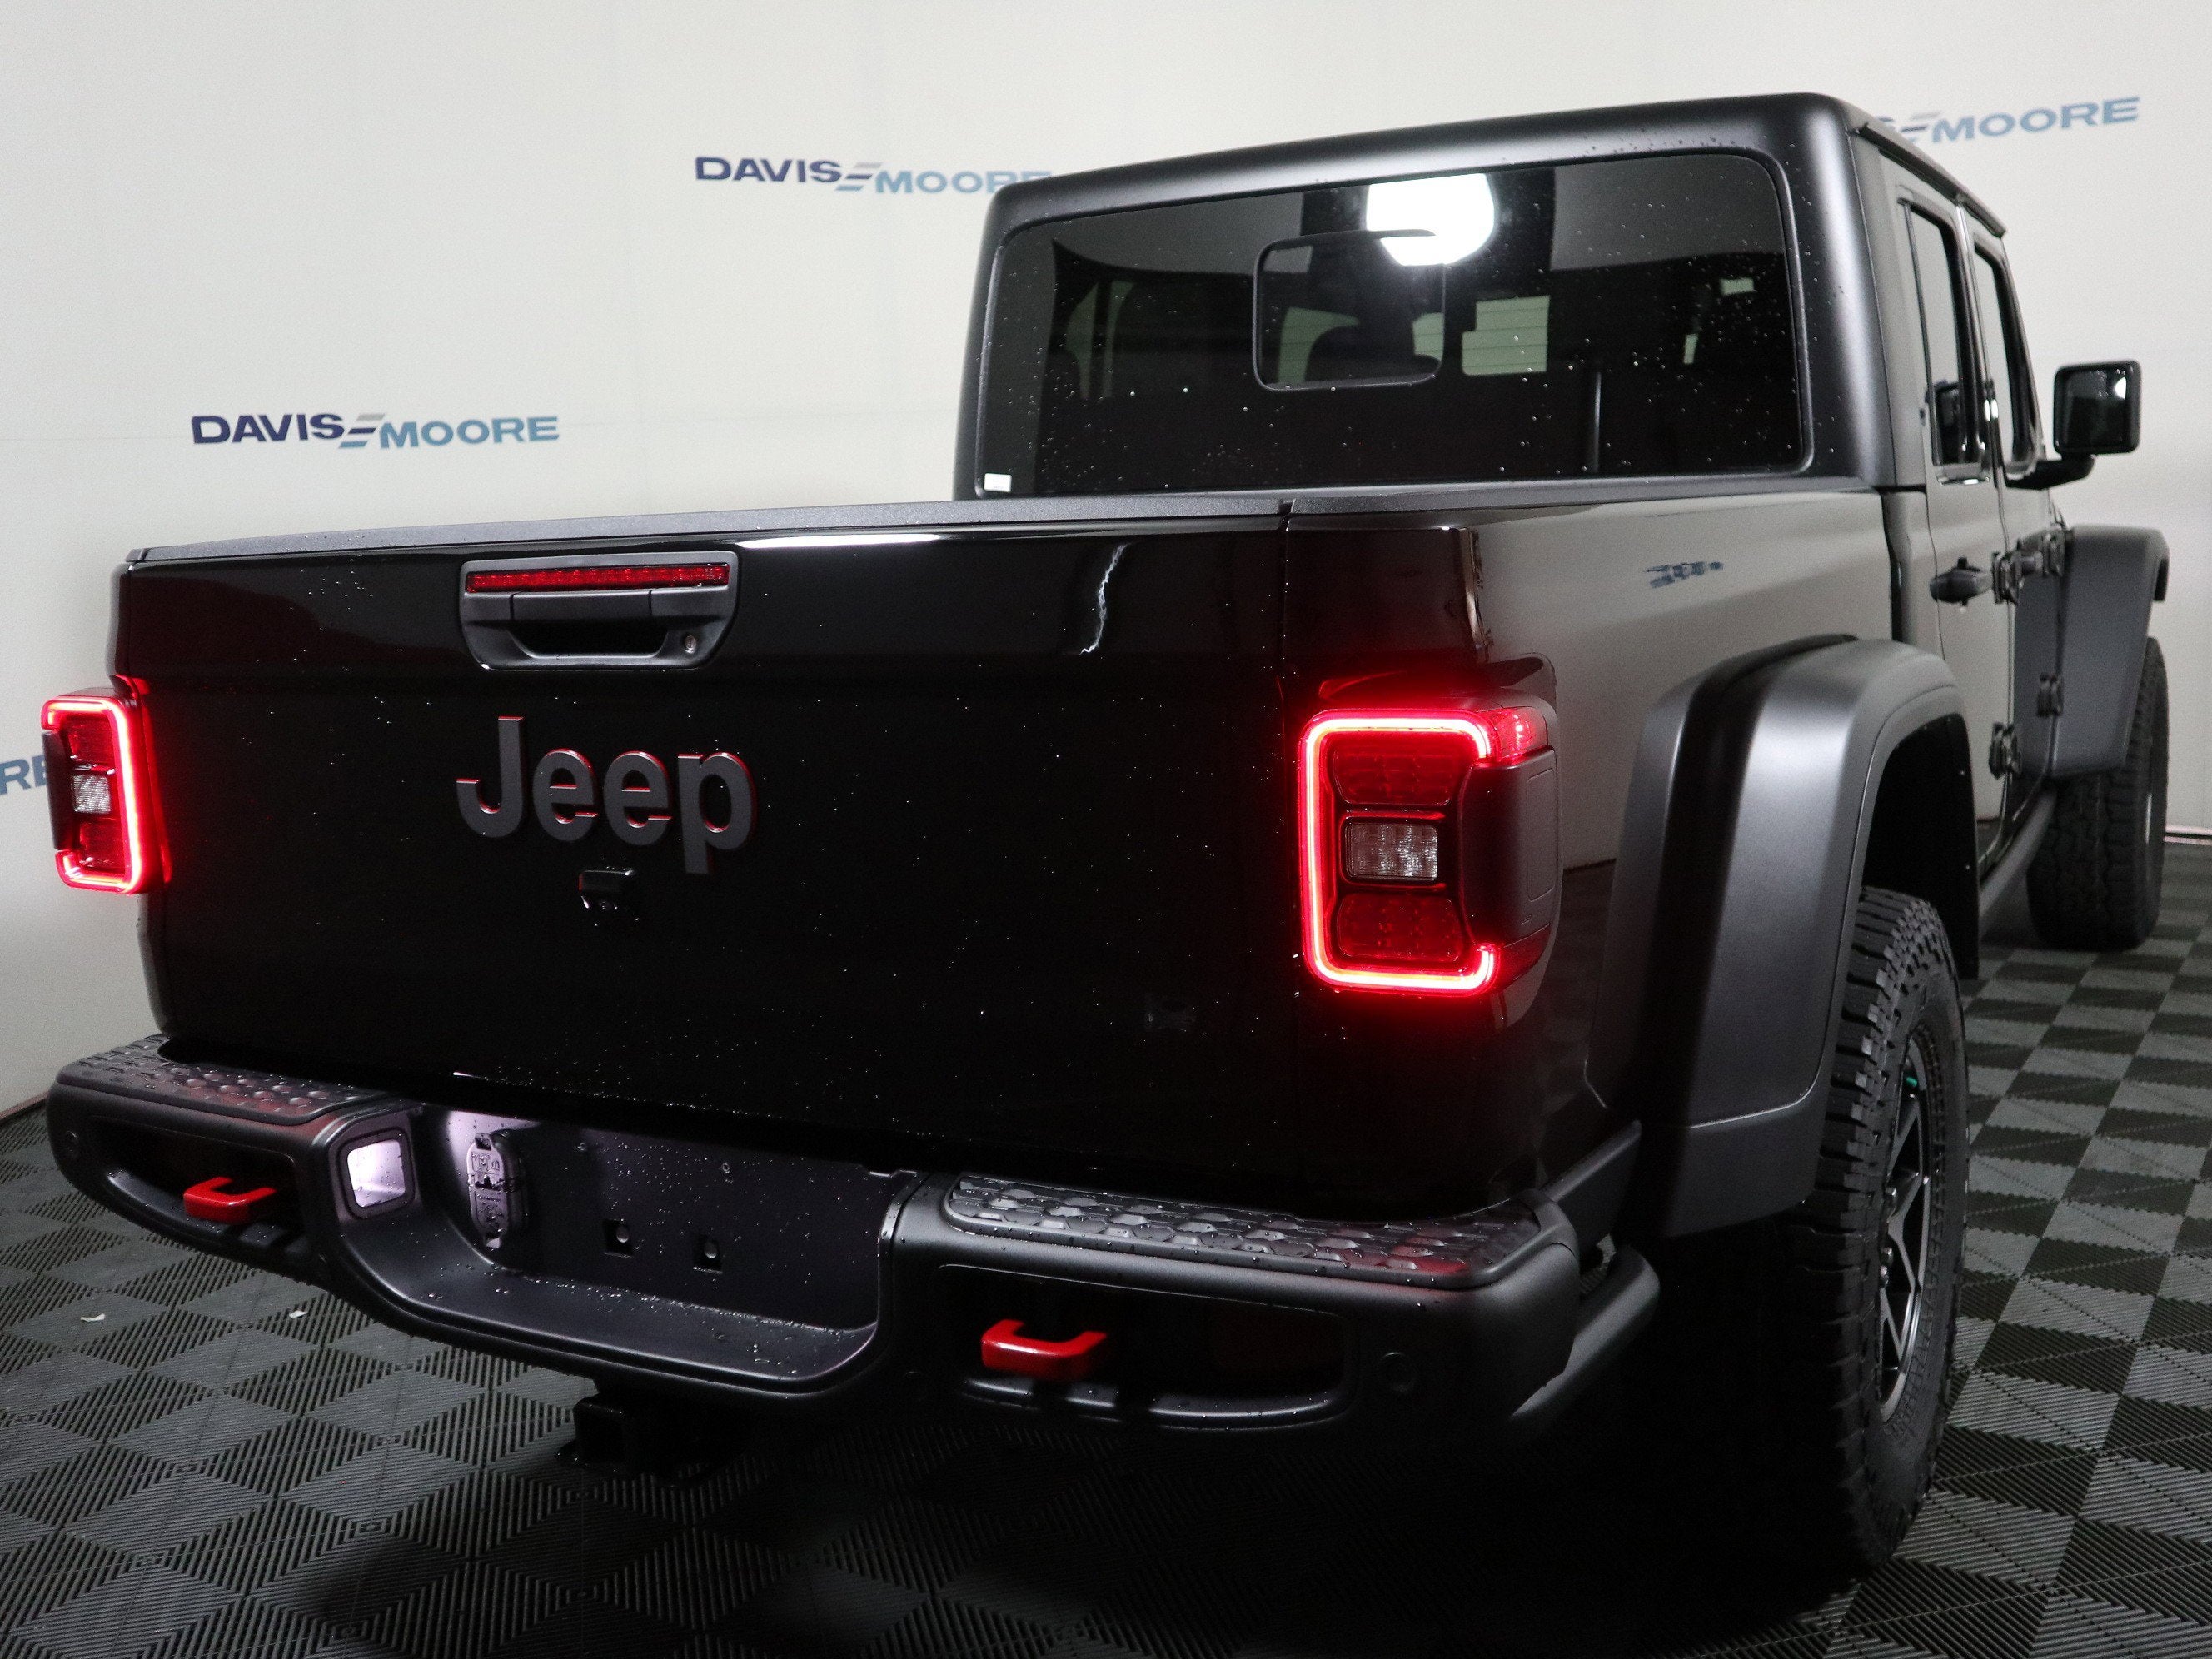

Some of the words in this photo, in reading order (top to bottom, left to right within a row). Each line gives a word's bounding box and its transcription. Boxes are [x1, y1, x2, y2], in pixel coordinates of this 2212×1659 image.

[1932, 97, 2140, 143] MOORE
[695, 156, 841, 182] DAVIS
[875, 170, 1052, 193] MOOR
[192, 413, 345, 444] DAVIS
[380, 416, 560, 449] MOORE
[456, 715, 758, 874] Jeep
